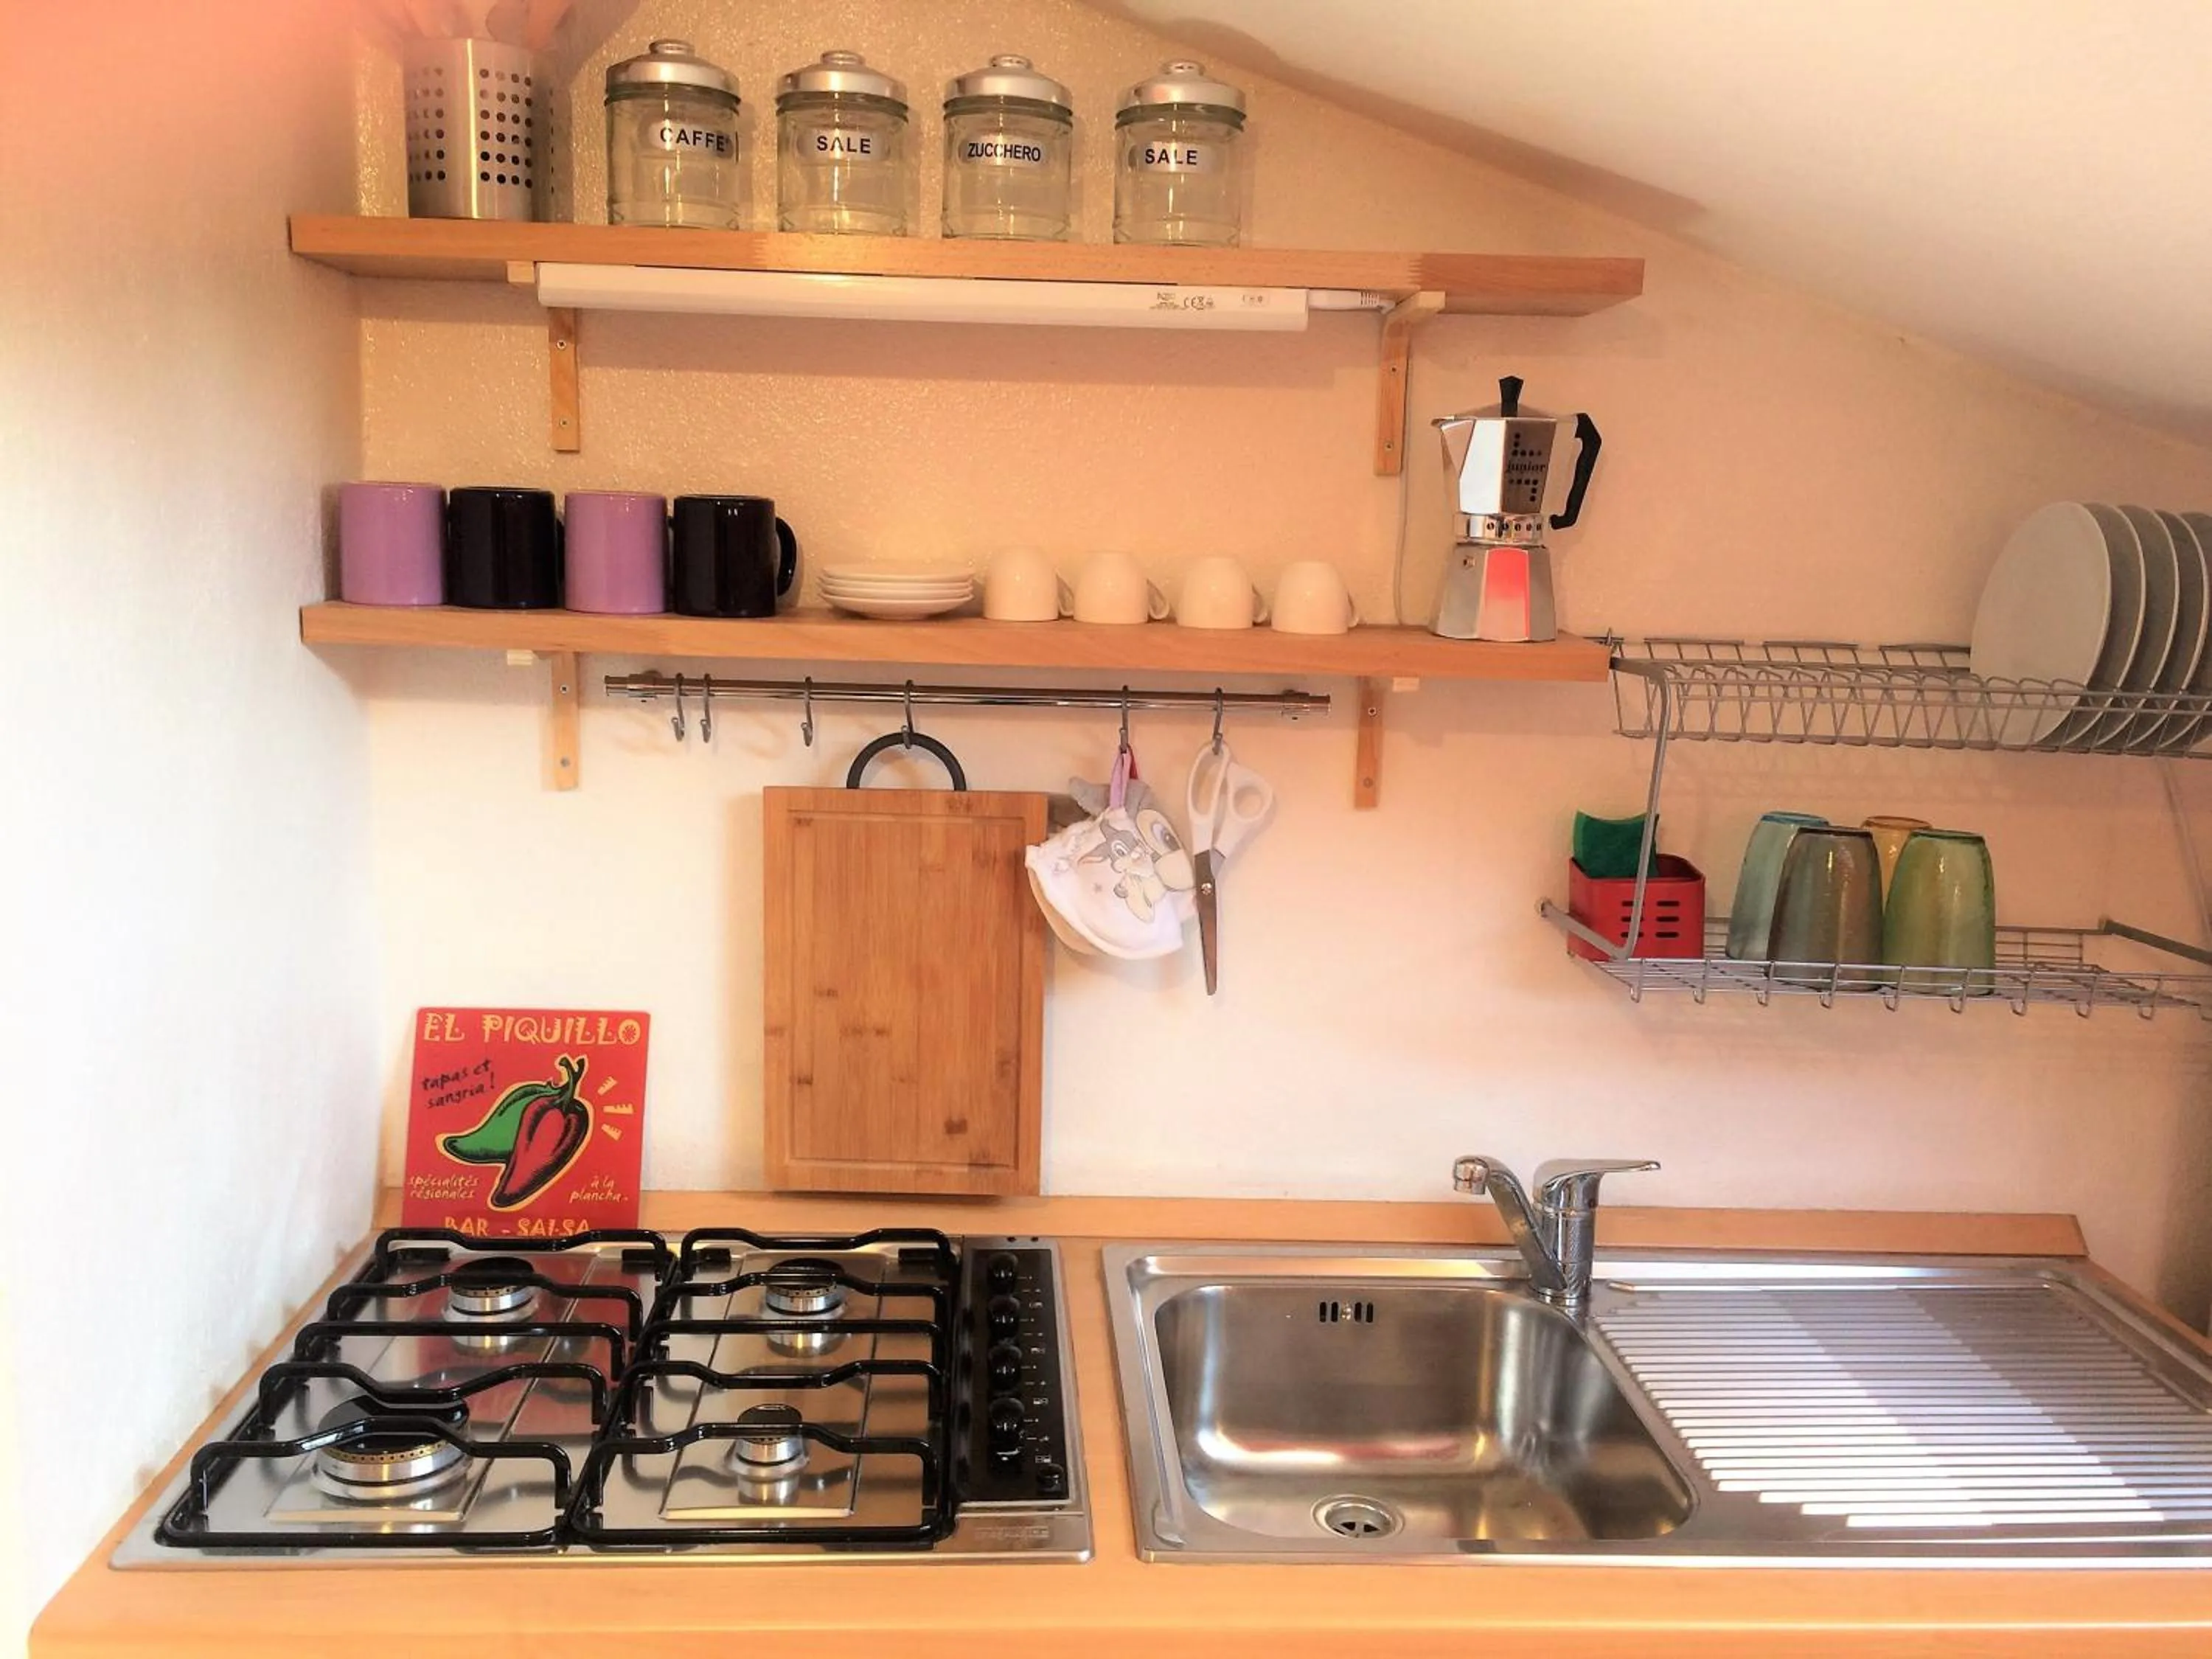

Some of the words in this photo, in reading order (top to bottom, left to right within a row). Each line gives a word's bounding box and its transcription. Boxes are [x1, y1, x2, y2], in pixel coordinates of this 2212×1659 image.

[816, 135, 872, 154] SALE
[967, 142, 1041, 162] ZUCCHERO
[1144, 148, 1198, 166] SALE
[423, 1012, 465, 1042] EL
[481, 1014, 641, 1046] PIQUILLO
[422, 1067, 469, 1091] tapas
[444, 1217, 489, 1237] BAR
[518, 1217, 590, 1237] SALSA
